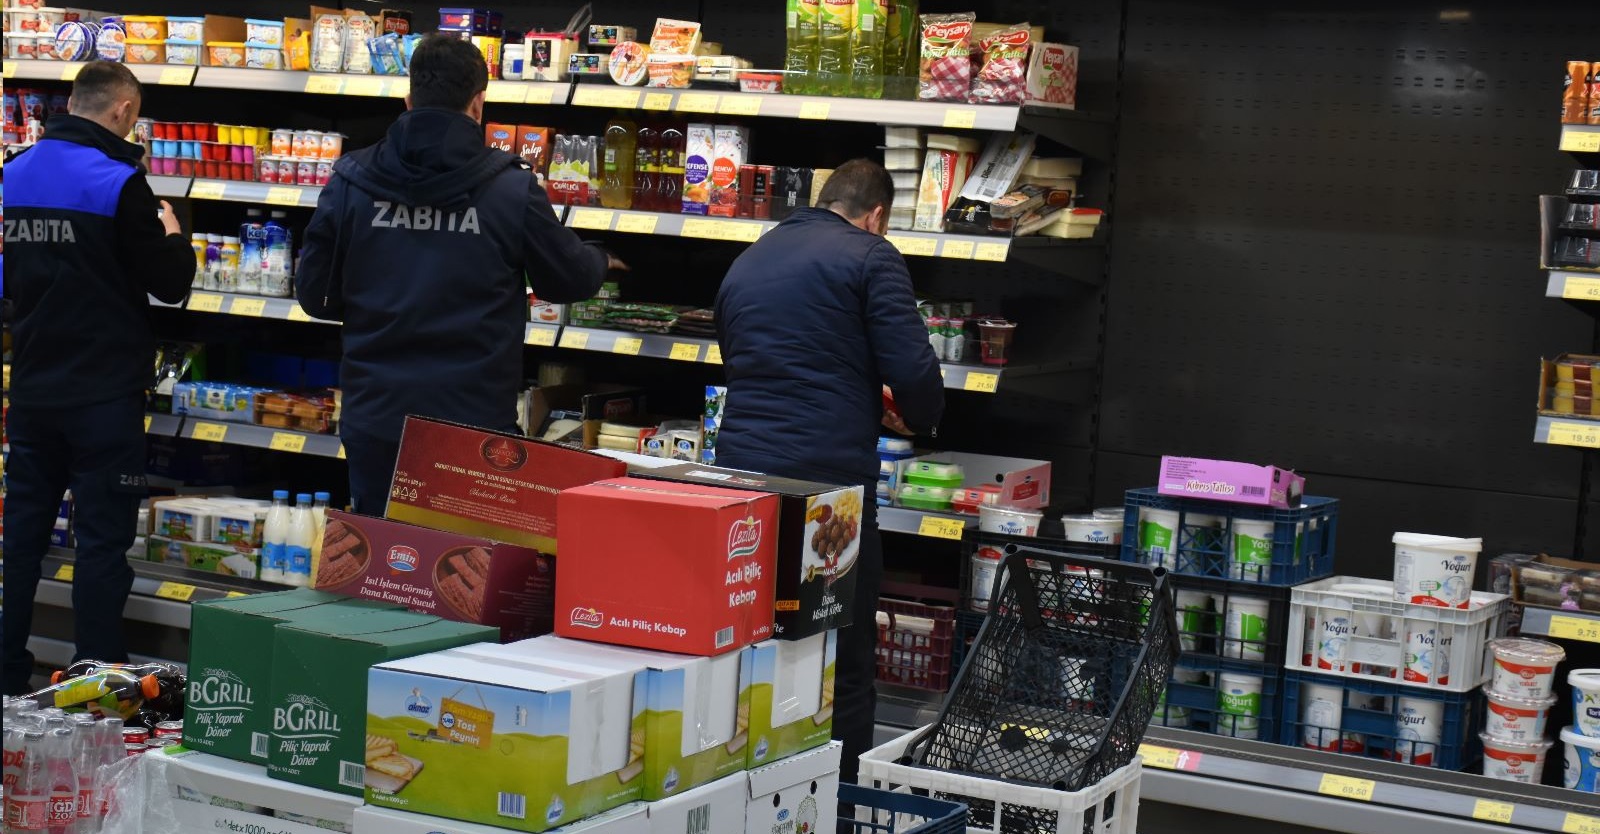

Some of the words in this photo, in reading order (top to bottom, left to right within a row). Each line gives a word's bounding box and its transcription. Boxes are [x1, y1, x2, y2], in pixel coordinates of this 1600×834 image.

[928, 24, 970, 40] Peysan
[1044, 52, 1064, 67] Peysan
[520, 143, 542, 158] Salep
[372, 201, 480, 234] ZABITA
[4, 219, 76, 243] ZABITA
[1571, 433, 1597, 443] 19.50
[731, 524, 757, 547] Lezita
[938, 526, 959, 535] 71.50
[390, 549, 417, 565] Emin
[725, 568, 743, 586] Acılı
[744, 564, 762, 581] Piliç
[379, 576, 401, 591] İşlem
[401, 582, 433, 598] Görmüş
[360, 586, 382, 600] Dana
[382, 590, 412, 606] Kangal
[412, 596, 437, 610] Sucuk
[729, 588, 757, 608] Kebap
[574, 609, 600, 622] Lezita
[609, 616, 631, 628] Acılı
[632, 619, 652, 632] Piliç
[654, 622, 687, 637] Kebap
[1577, 628, 1598, 638] 9.75
[189, 676, 254, 704] BGRILL
[1221, 693, 1252, 709] Yoğurt
[195, 712, 213, 727] Piliç
[215, 712, 245, 727] Yaprak
[273, 703, 341, 732] BGRILL
[457, 719, 477, 732] Tost
[205, 726, 232, 738] Döner
[450, 729, 481, 745] Peyniri
[279, 740, 298, 754] Piliç
[300, 741, 332, 755] Yaprak
[290, 754, 319, 766] Döner
[1342, 786, 1367, 796] 69.50
